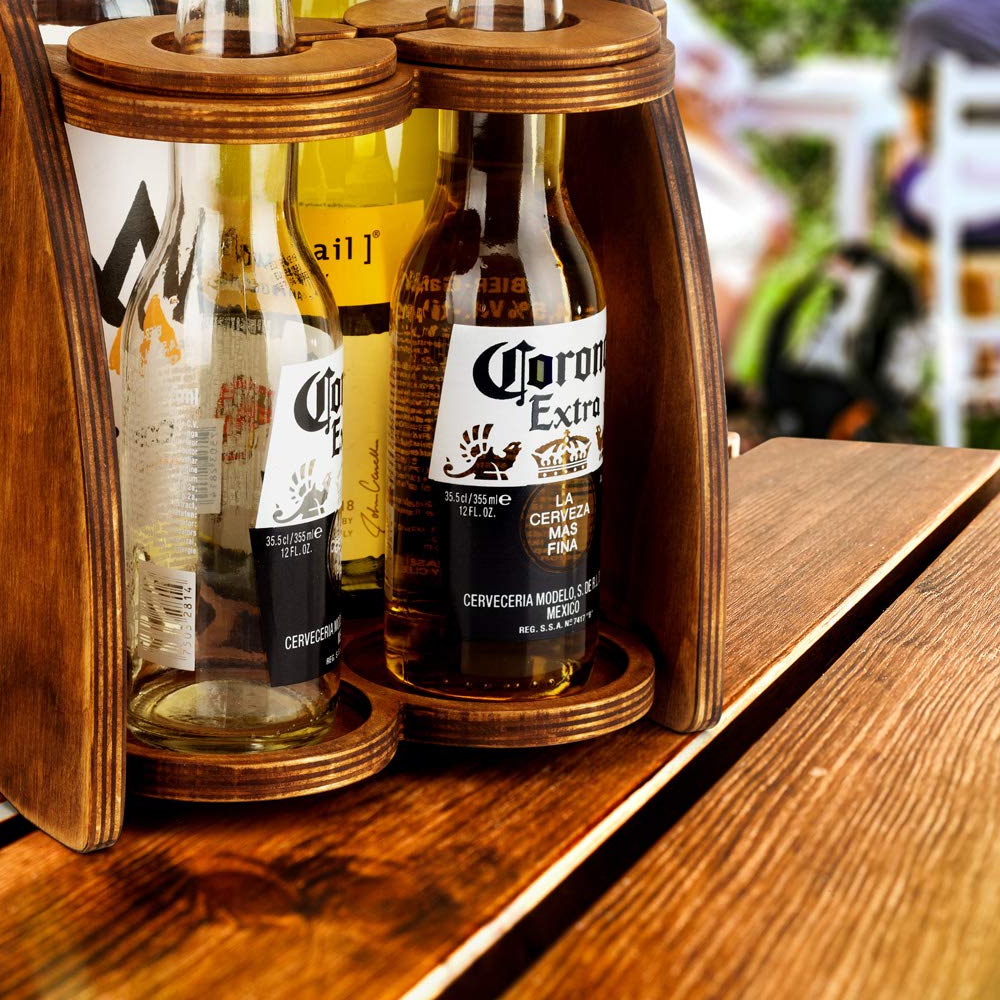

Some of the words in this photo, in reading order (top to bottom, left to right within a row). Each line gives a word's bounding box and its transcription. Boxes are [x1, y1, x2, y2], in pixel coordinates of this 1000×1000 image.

[529, 393, 600, 432] Extra
[555, 492, 573, 507] LA
[529, 502, 590, 526] CERVEZA
[548, 521, 578, 540] MAS
[547, 538, 578, 556] FINA
[463, 593, 534, 608] CERVECERIA
[535, 586, 577, 607] MODELO,
[546, 599, 580, 620] MEXICO
[284, 621, 334, 650] CERVECERIA
[518, 625, 539, 634] REG.
